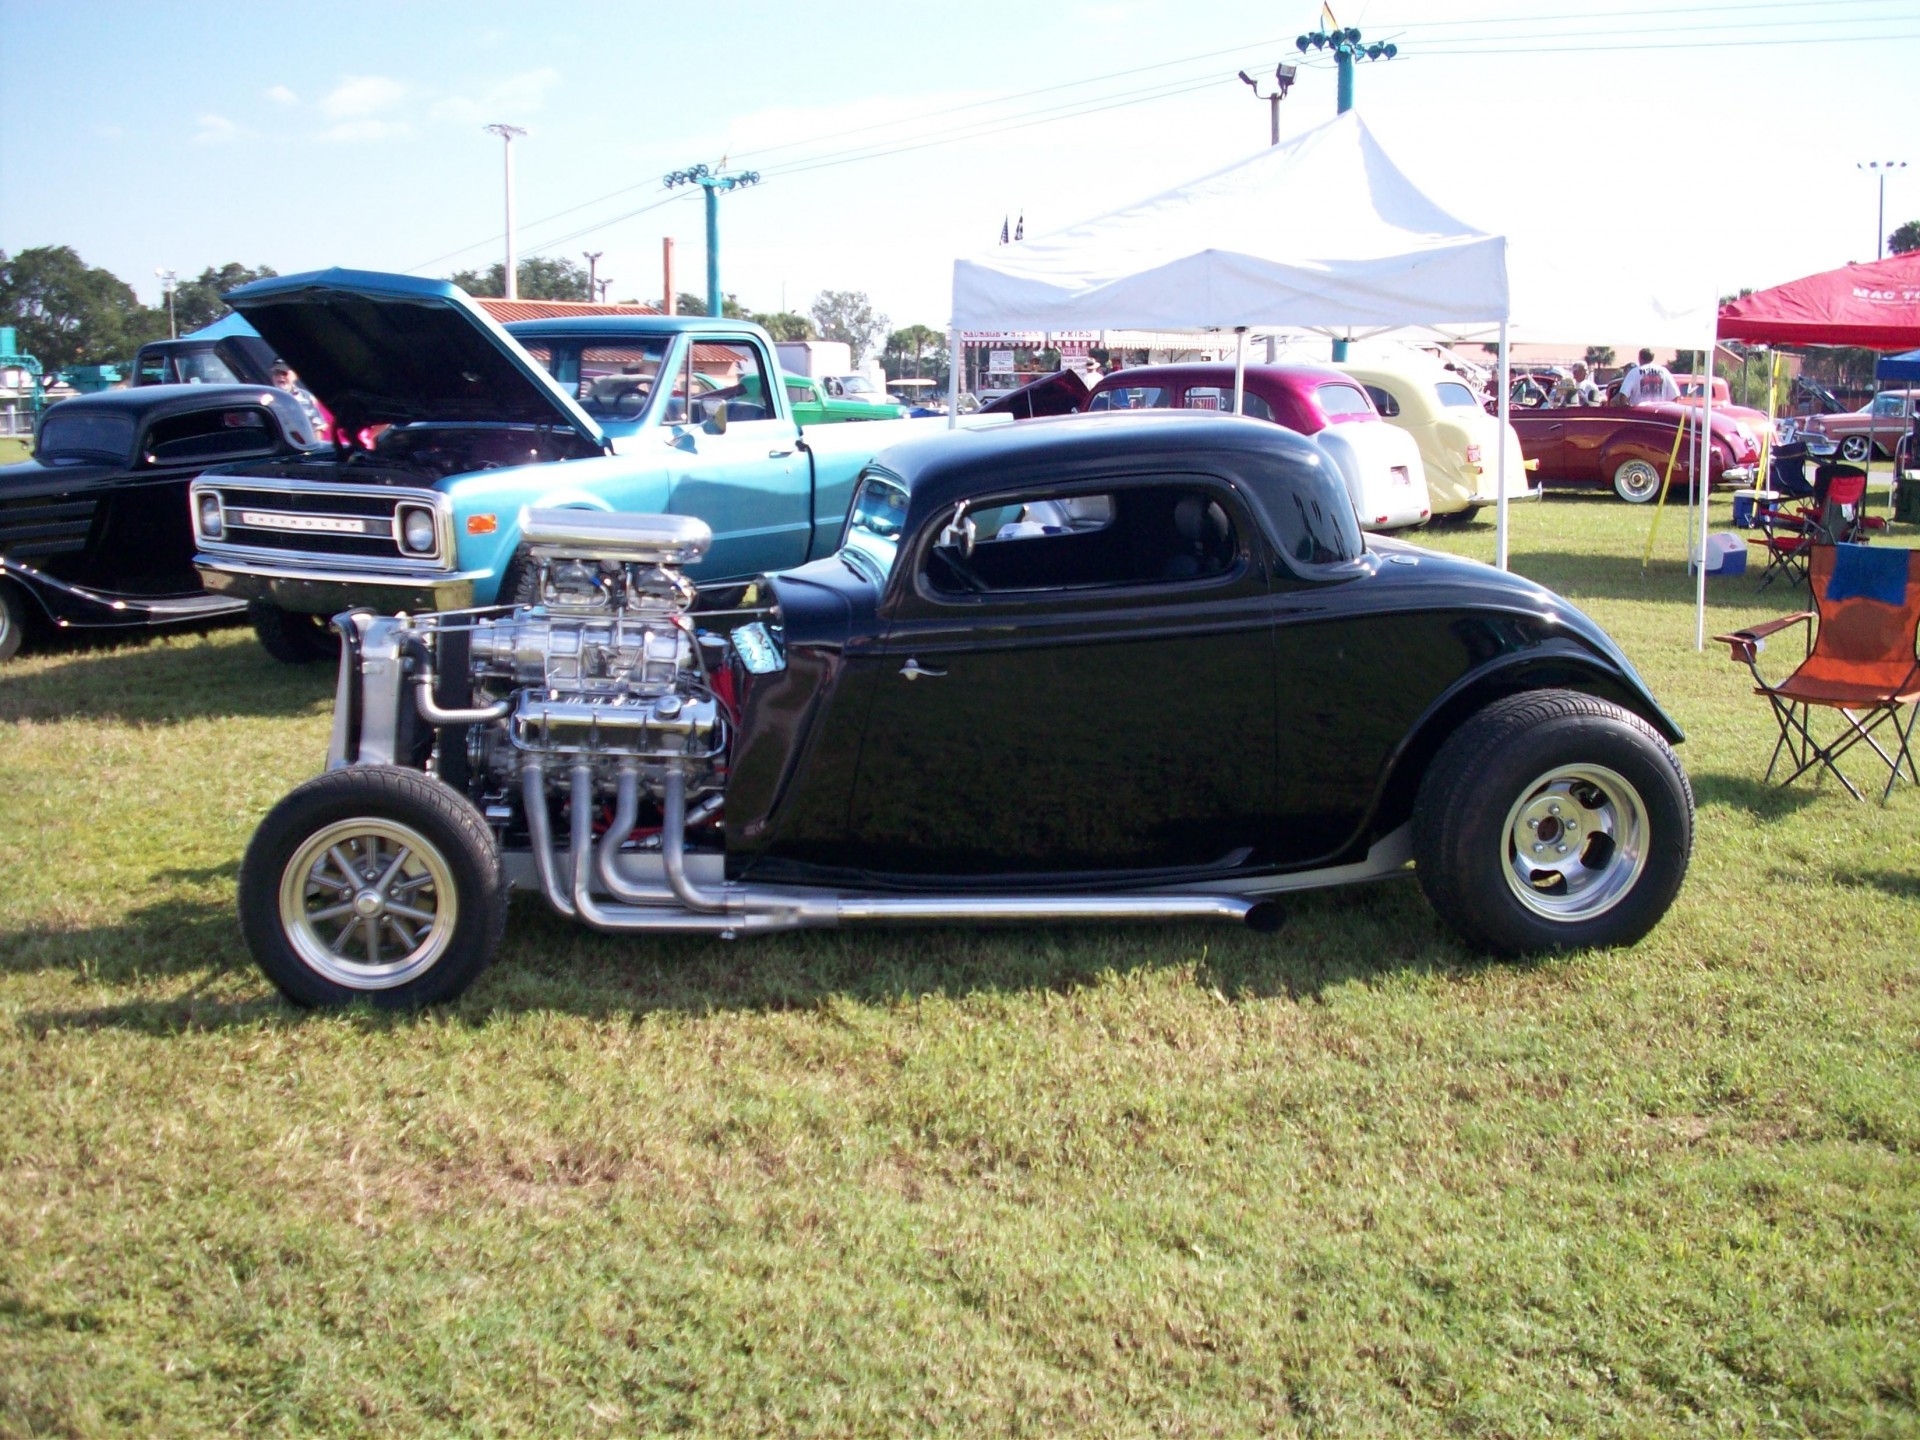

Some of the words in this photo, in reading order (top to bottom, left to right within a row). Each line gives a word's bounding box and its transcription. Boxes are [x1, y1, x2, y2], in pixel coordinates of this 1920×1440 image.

[1852, 287, 1895, 300] MAC
[1060, 330, 1092, 338] FRIES
[247, 515, 357, 528] CHEVROLET
